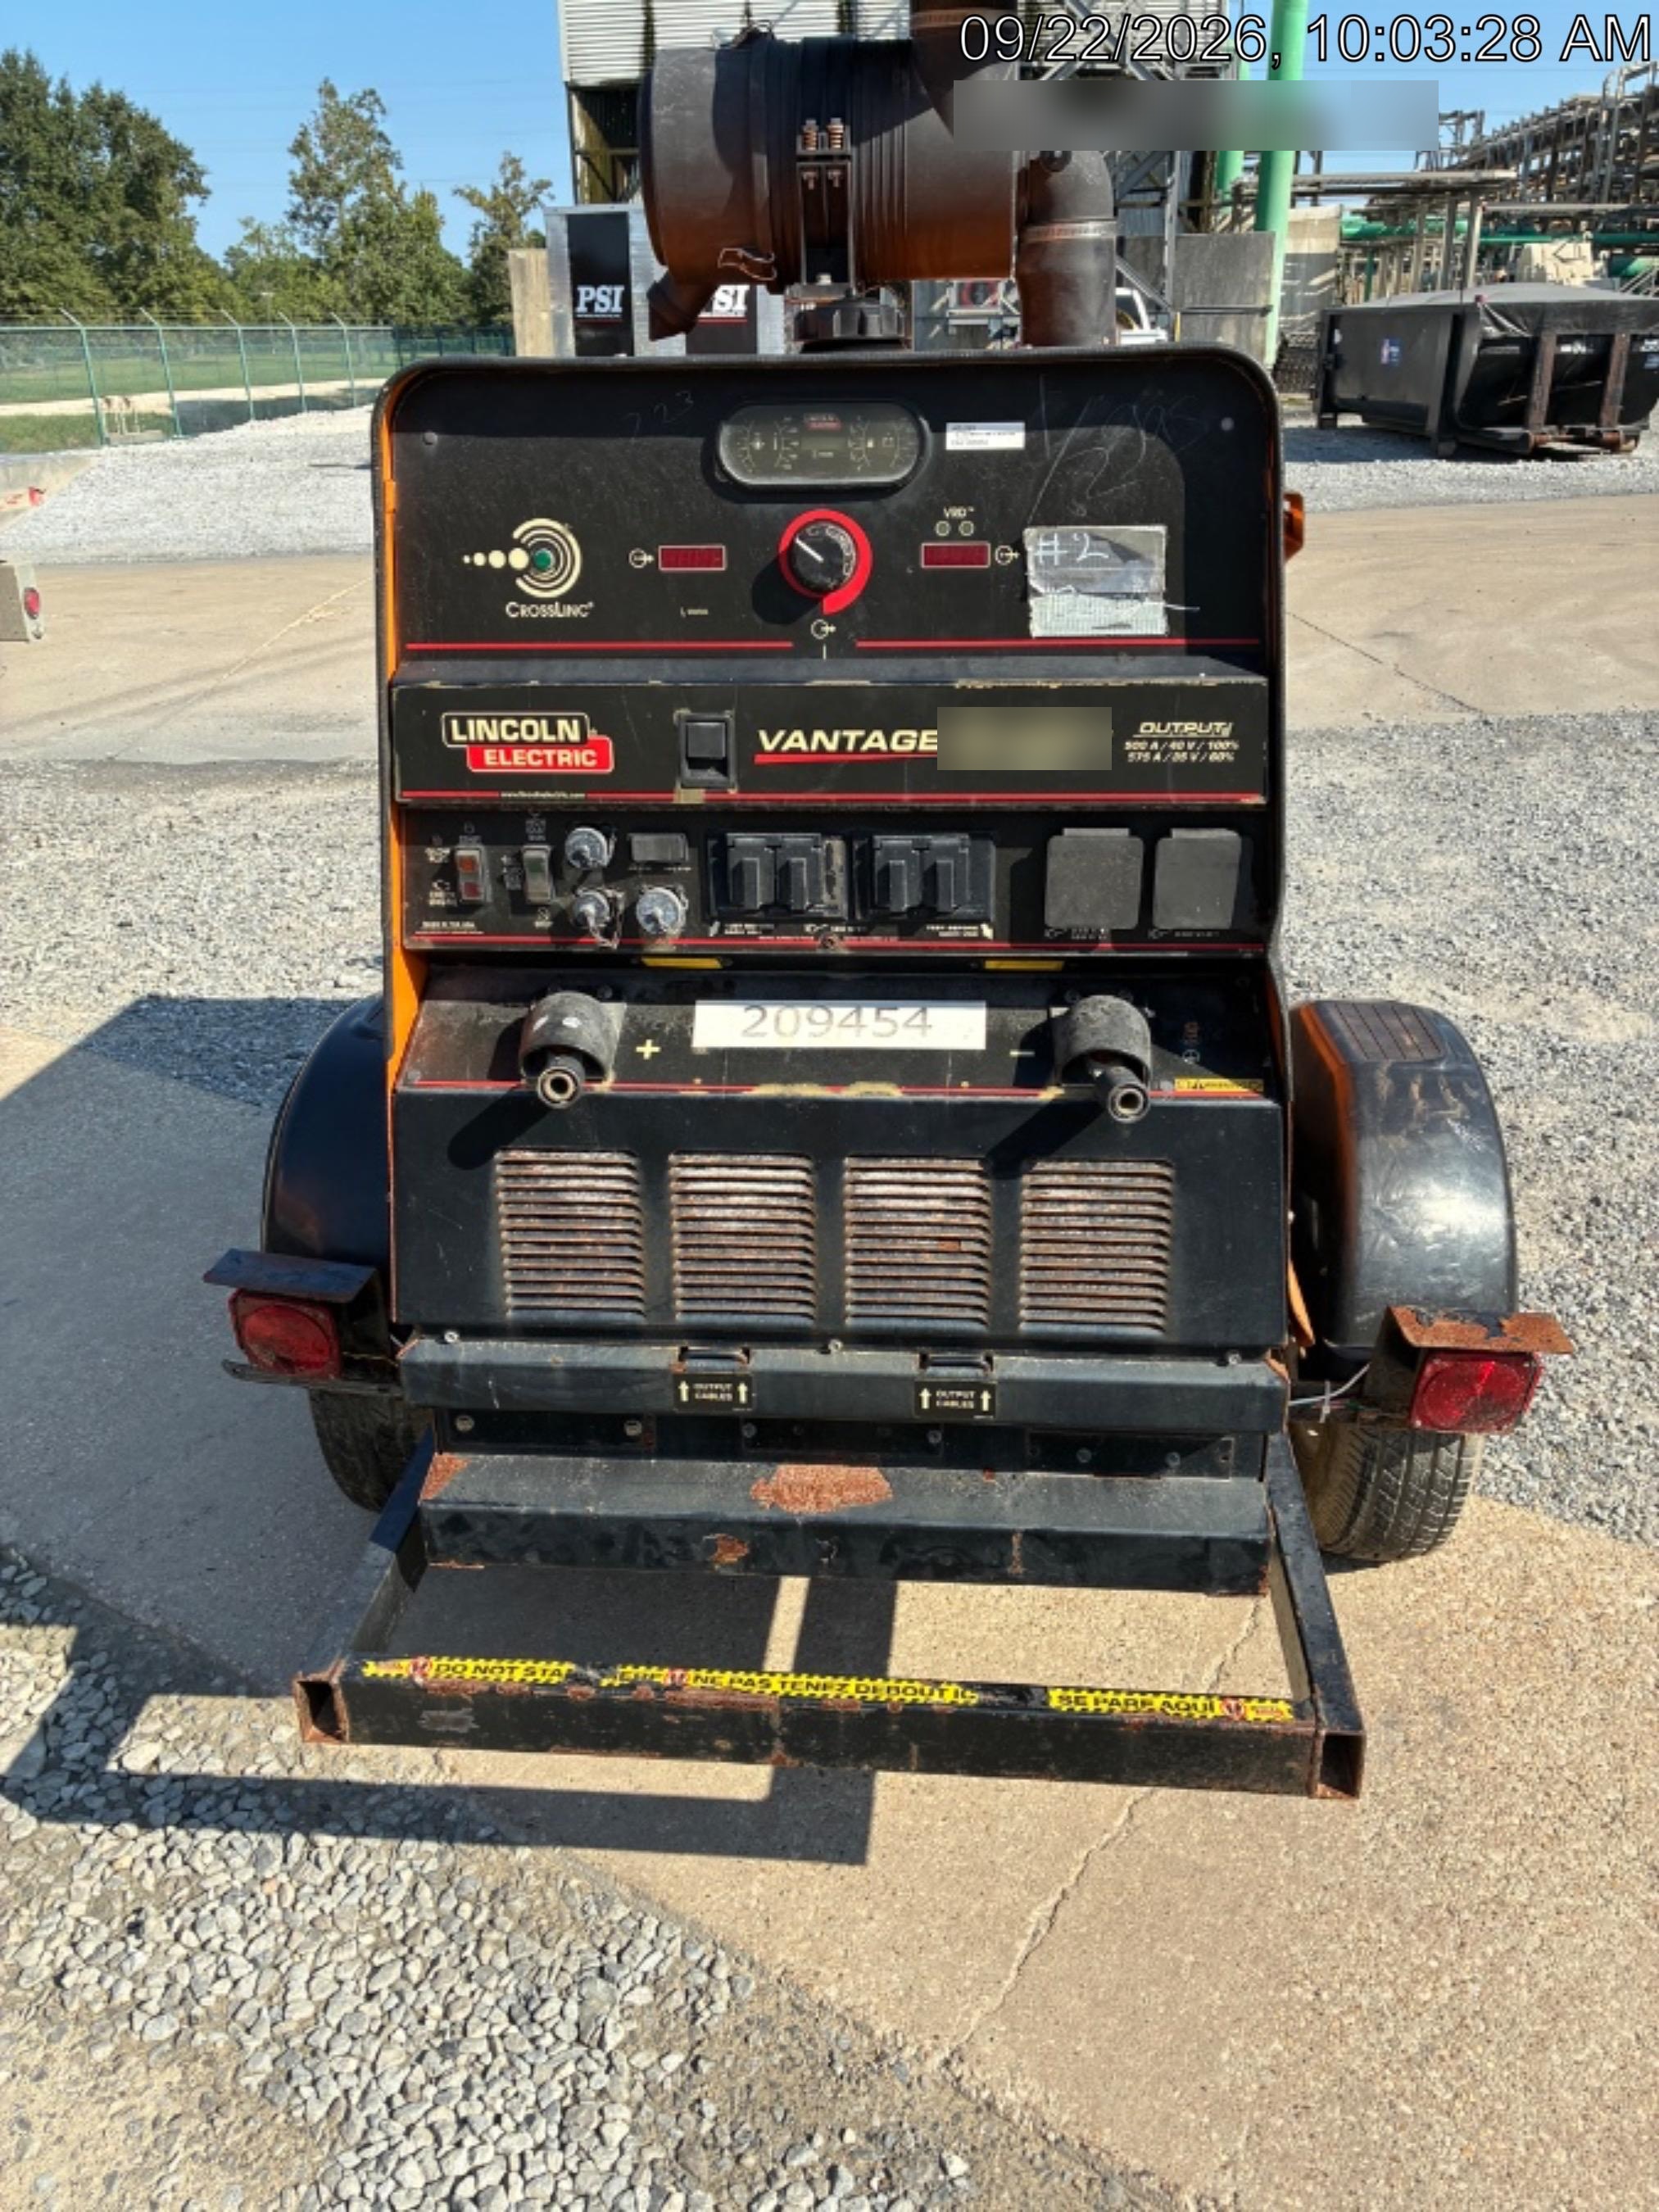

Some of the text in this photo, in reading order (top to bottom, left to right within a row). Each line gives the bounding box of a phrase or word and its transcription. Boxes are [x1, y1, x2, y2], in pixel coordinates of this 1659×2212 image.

[576, 285, 624, 313] PSI
[701, 284, 750, 311] SI
[450, 718, 581, 742] LINCOLN
[1139, 721, 1225, 735] OUTPUT
[757, 728, 937, 753] VANTAGE
[483, 749, 598, 767] ELECTRIC
[741, 1004, 933, 1039] 209454
[434, 1662, 469, 1675] DO
[471, 1664, 519, 1677] NOT
[728, 1677, 772, 1689] PAS
[779, 1679, 850, 1693] TENEZ
[854, 1682, 950, 1699] DEBOUT
